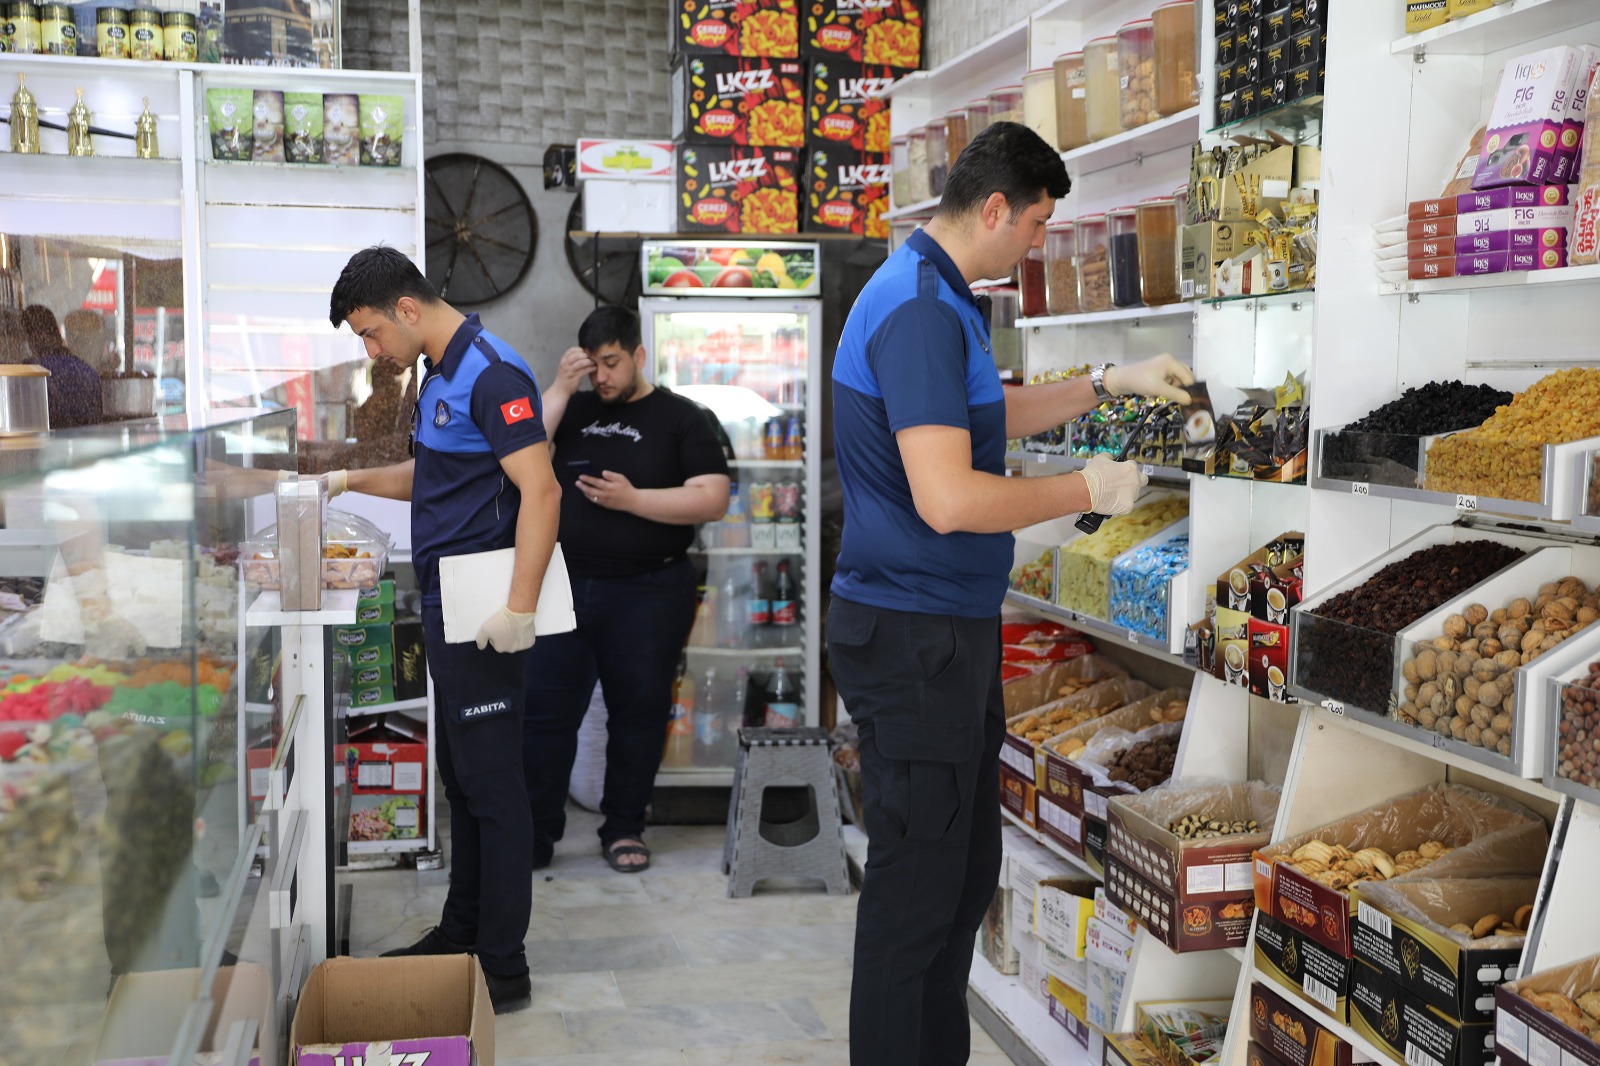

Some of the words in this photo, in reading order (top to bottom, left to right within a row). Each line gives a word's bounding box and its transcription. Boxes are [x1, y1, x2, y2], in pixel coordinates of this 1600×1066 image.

[1410, 1, 1445, 12] MAHMOOD
[1412, 13, 1432, 23] Gold
[715, 68, 775, 94] LKZZ
[838, 77, 895, 99] LKZZ
[1513, 86, 1534, 104] FIG
[1551, 90, 1566, 112] FIG
[1572, 89, 1586, 111] FIG
[708, 157, 767, 182] LKZZ
[838, 164, 893, 187] LKZZ
[1514, 208, 1535, 220] FIG
[1474, 218, 1490, 232] FIG
[1585, 208, 1599, 252] Petit
[1353, 483, 1368, 495] 200
[1458, 495, 1476, 509] 200
[464, 701, 507, 717] ZABITA
[1327, 702, 1343, 715] 200
